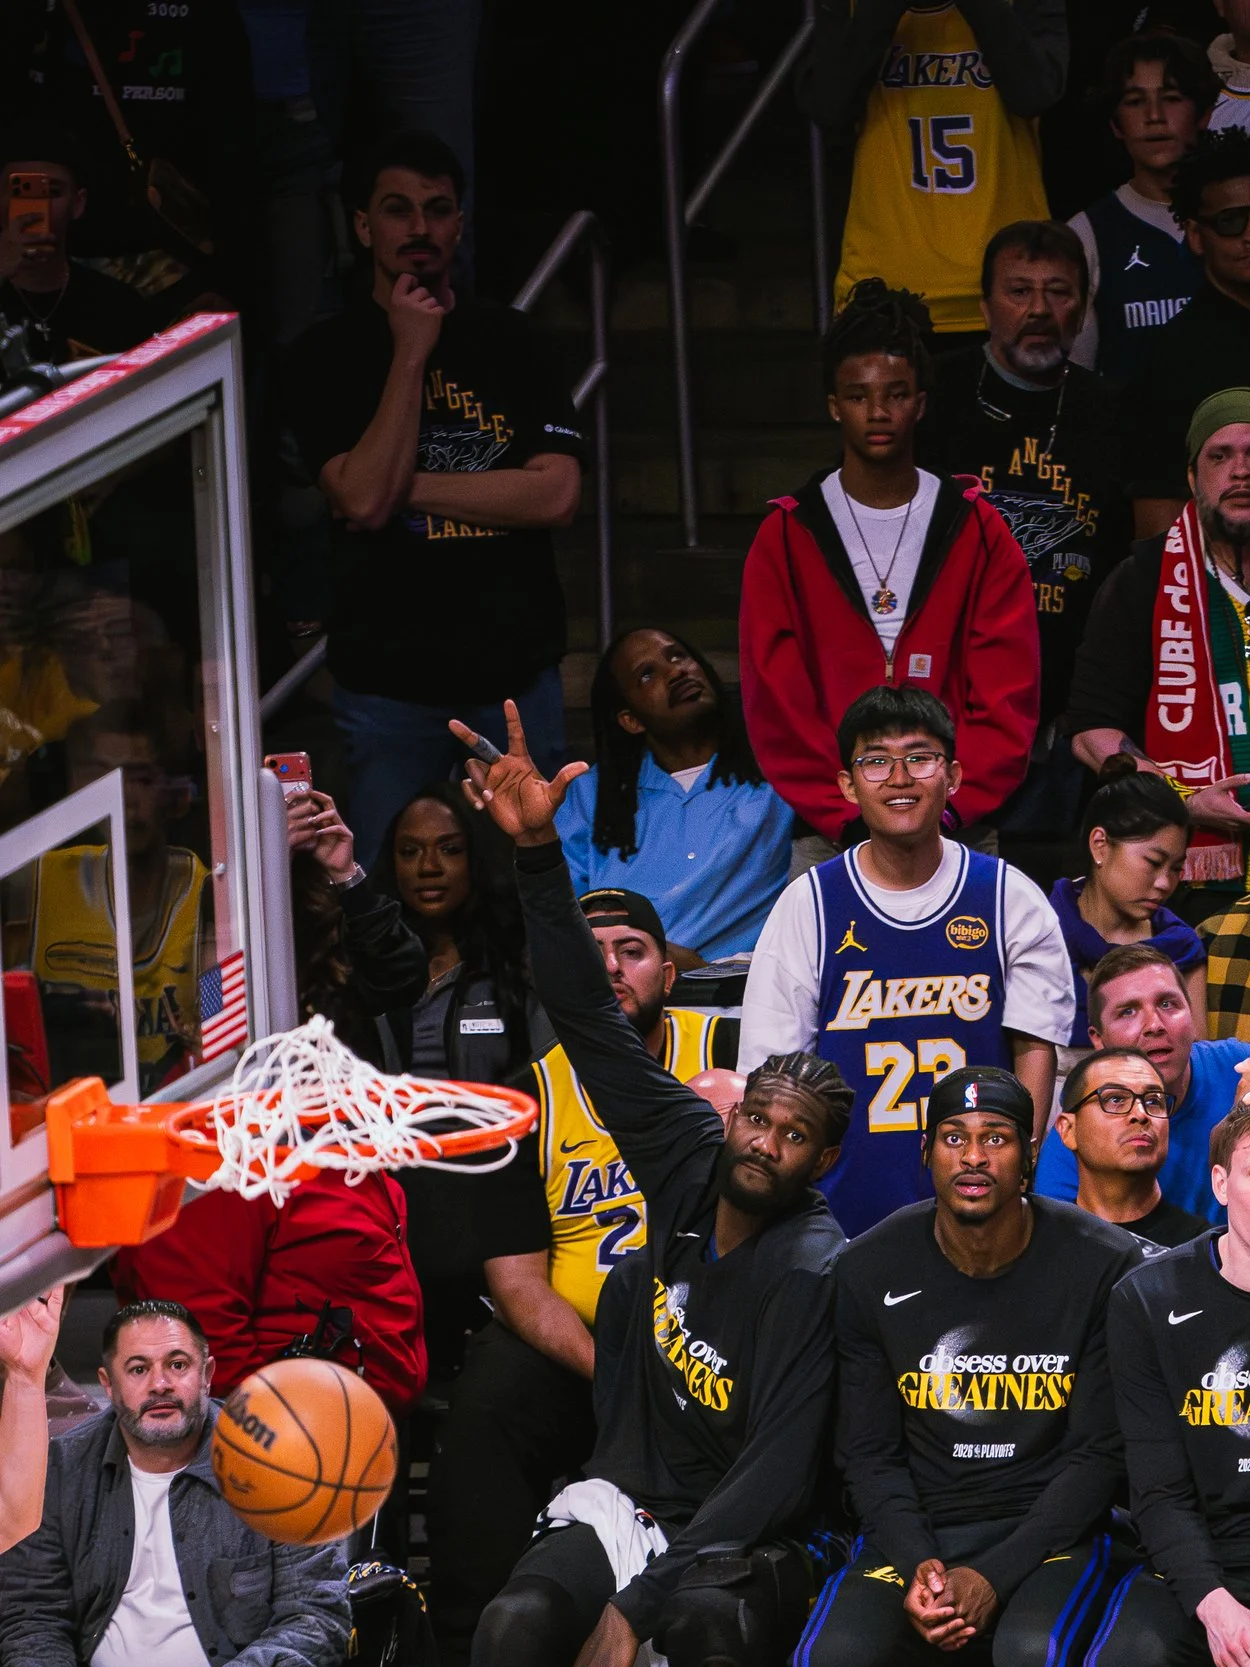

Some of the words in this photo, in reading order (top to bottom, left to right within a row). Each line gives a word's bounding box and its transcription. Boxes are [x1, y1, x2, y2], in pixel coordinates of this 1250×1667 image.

[908, 114, 978, 195] 15
[1007, 436, 1100, 537] ANGELES
[1156, 618, 1199, 734] CLUBE
[950, 924, 986, 939] bibigo
[825, 969, 992, 1031] LAKERS
[918, 1344, 1008, 1374] obsess
[1012, 1353, 1070, 1374] over
[896, 1371, 1076, 1412] GREATNESS
[952, 1442, 974, 1459] 2026
[980, 1442, 1017, 1459] PLAYOFFS
